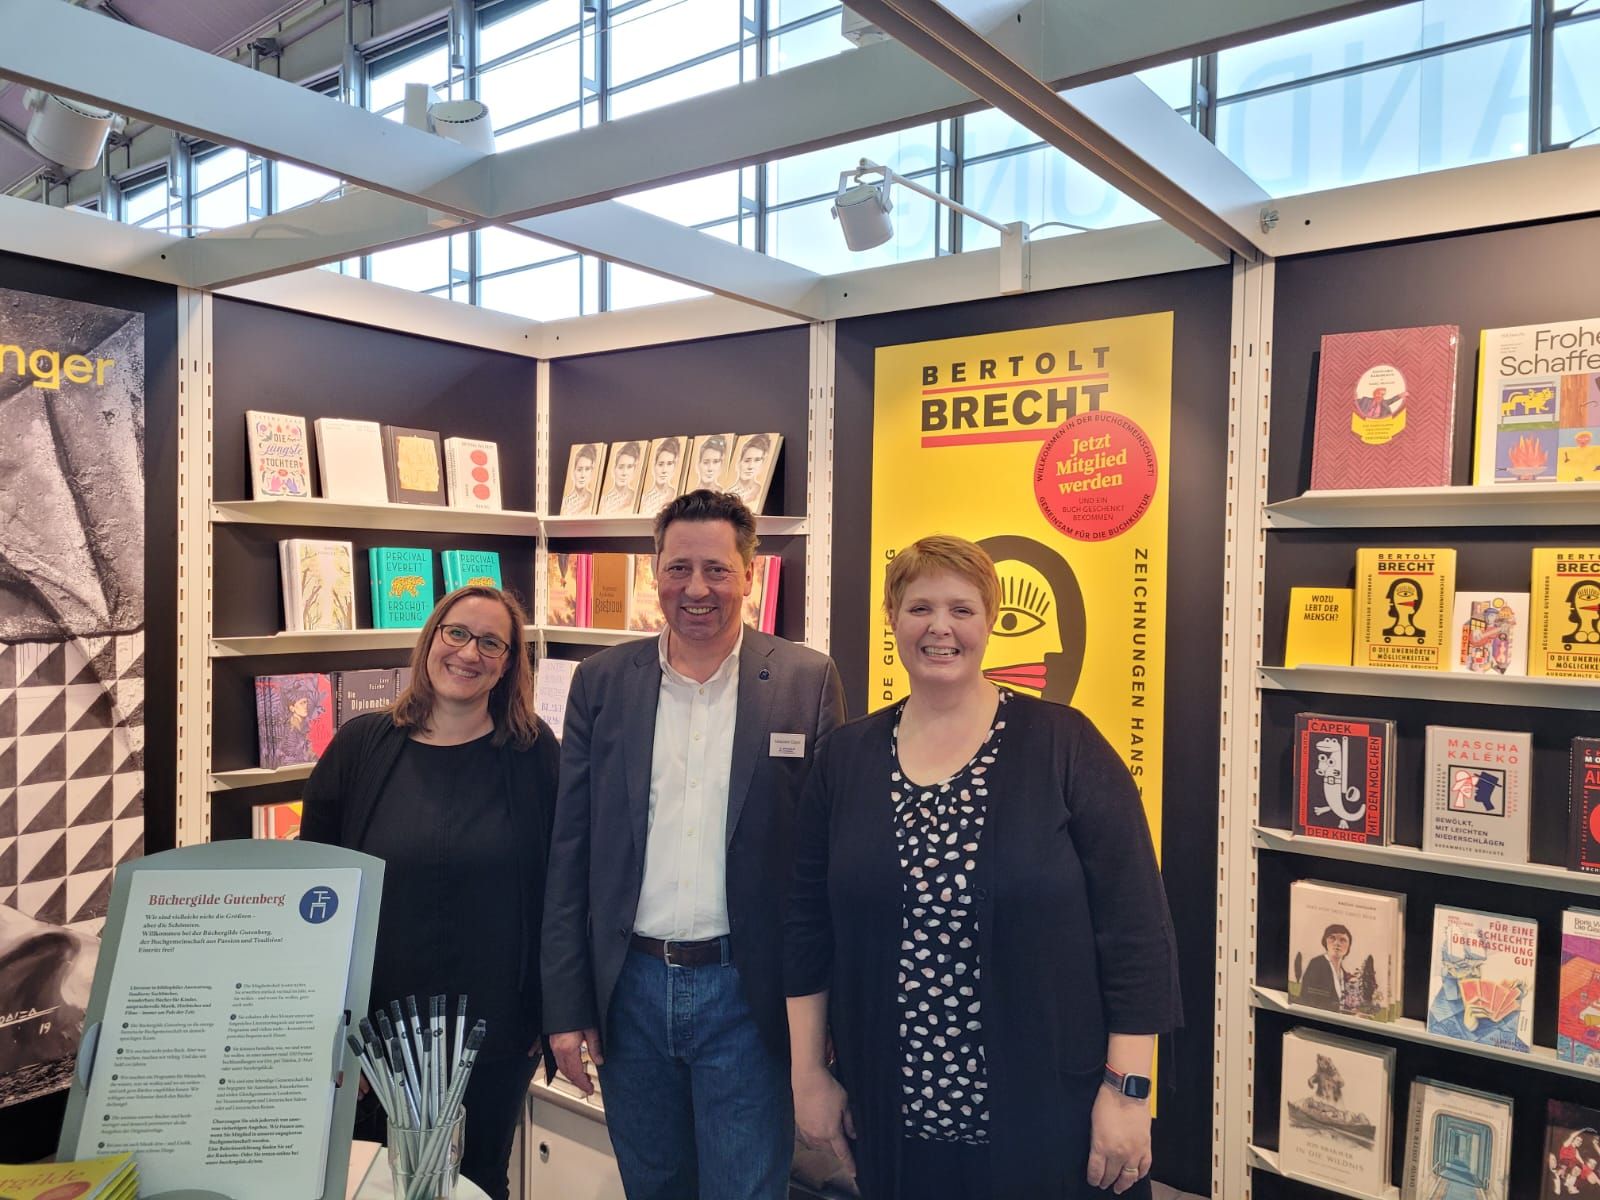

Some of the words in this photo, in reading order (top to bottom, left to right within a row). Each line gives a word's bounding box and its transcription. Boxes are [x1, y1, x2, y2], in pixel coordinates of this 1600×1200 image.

[1535, 326, 1600, 351] Froh
[922, 346, 1110, 386] BERTOLT
[921, 383, 1109, 432] BRECHT
[273, 433, 287, 443] DIE
[1070, 433, 1111, 457] Jetzt
[1037, 428, 1066, 483] WILLKOMMEN
[1066, 421, 1075, 431] IN
[1077, 415, 1092, 425] DER
[1056, 448, 1127, 476] Mitglied
[1058, 473, 1123, 495] werden
[1096, 496, 1108, 504] EIN
[1062, 505, 1081, 513] BUCH
[1082, 504, 1124, 513] GESCHENKT
[1039, 496, 1074, 534] GEMEINSAM
[1075, 530, 1091, 539] FÜR
[1092, 531, 1106, 539] DIE
[1108, 494, 1151, 536] BUCHKULTUR
[1072, 513, 1114, 521] BEKOMMEN
[386, 551, 427, 562] PERCIVAL
[460, 553, 496, 565] PERCIVAL
[386, 562, 424, 573] EVERETT
[461, 564, 493, 574] EVERETT
[1378, 562, 1436, 572] BRECHT
[1312, 595, 1334, 603] WOZU
[1305, 604, 1322, 612] LEBT
[1324, 604, 1339, 612] DER
[388, 611, 423, 622] TERUNG
[1304, 613, 1339, 622] MENSCH?
[1132, 548, 1148, 707] ZEICHNUNGEN
[1460, 627, 1469, 663] HOTEL
[1378, 653, 1430, 661] MÖGLICHKEITEN
[351, 696, 390, 711] Diplomatin
[1130, 717, 1145, 777] HANS
[1448, 738, 1519, 753] MASCHA
[1368, 738, 1379, 790] MOLCHEN
[1368, 792, 1378, 813] DEN
[1368, 814, 1378, 833] MIT
[1435, 816, 1474, 827] BEWÖLKT,
[1307, 828, 1330, 838] DER
[1332, 830, 1365, 843] KRIEG
[1435, 824, 1448, 832] MIT
[1450, 827, 1488, 837] LEICHTEN
[1435, 832, 1505, 848] NIEDERSCHLÄGEN
[148, 893, 221, 907] Büchergilde
[223, 893, 286, 907] Gutenberg
[203, 928, 238, 937] Büchergilde
[1489, 921, 1508, 932] FÜR
[1511, 926, 1534, 937] EINE
[1452, 934, 1533, 957] ÜBERRASCHUNG
[1478, 930, 1534, 947] SCHLECHTE
[1513, 956, 1534, 968] GUT
[39, 1022, 51, 1035] 19
